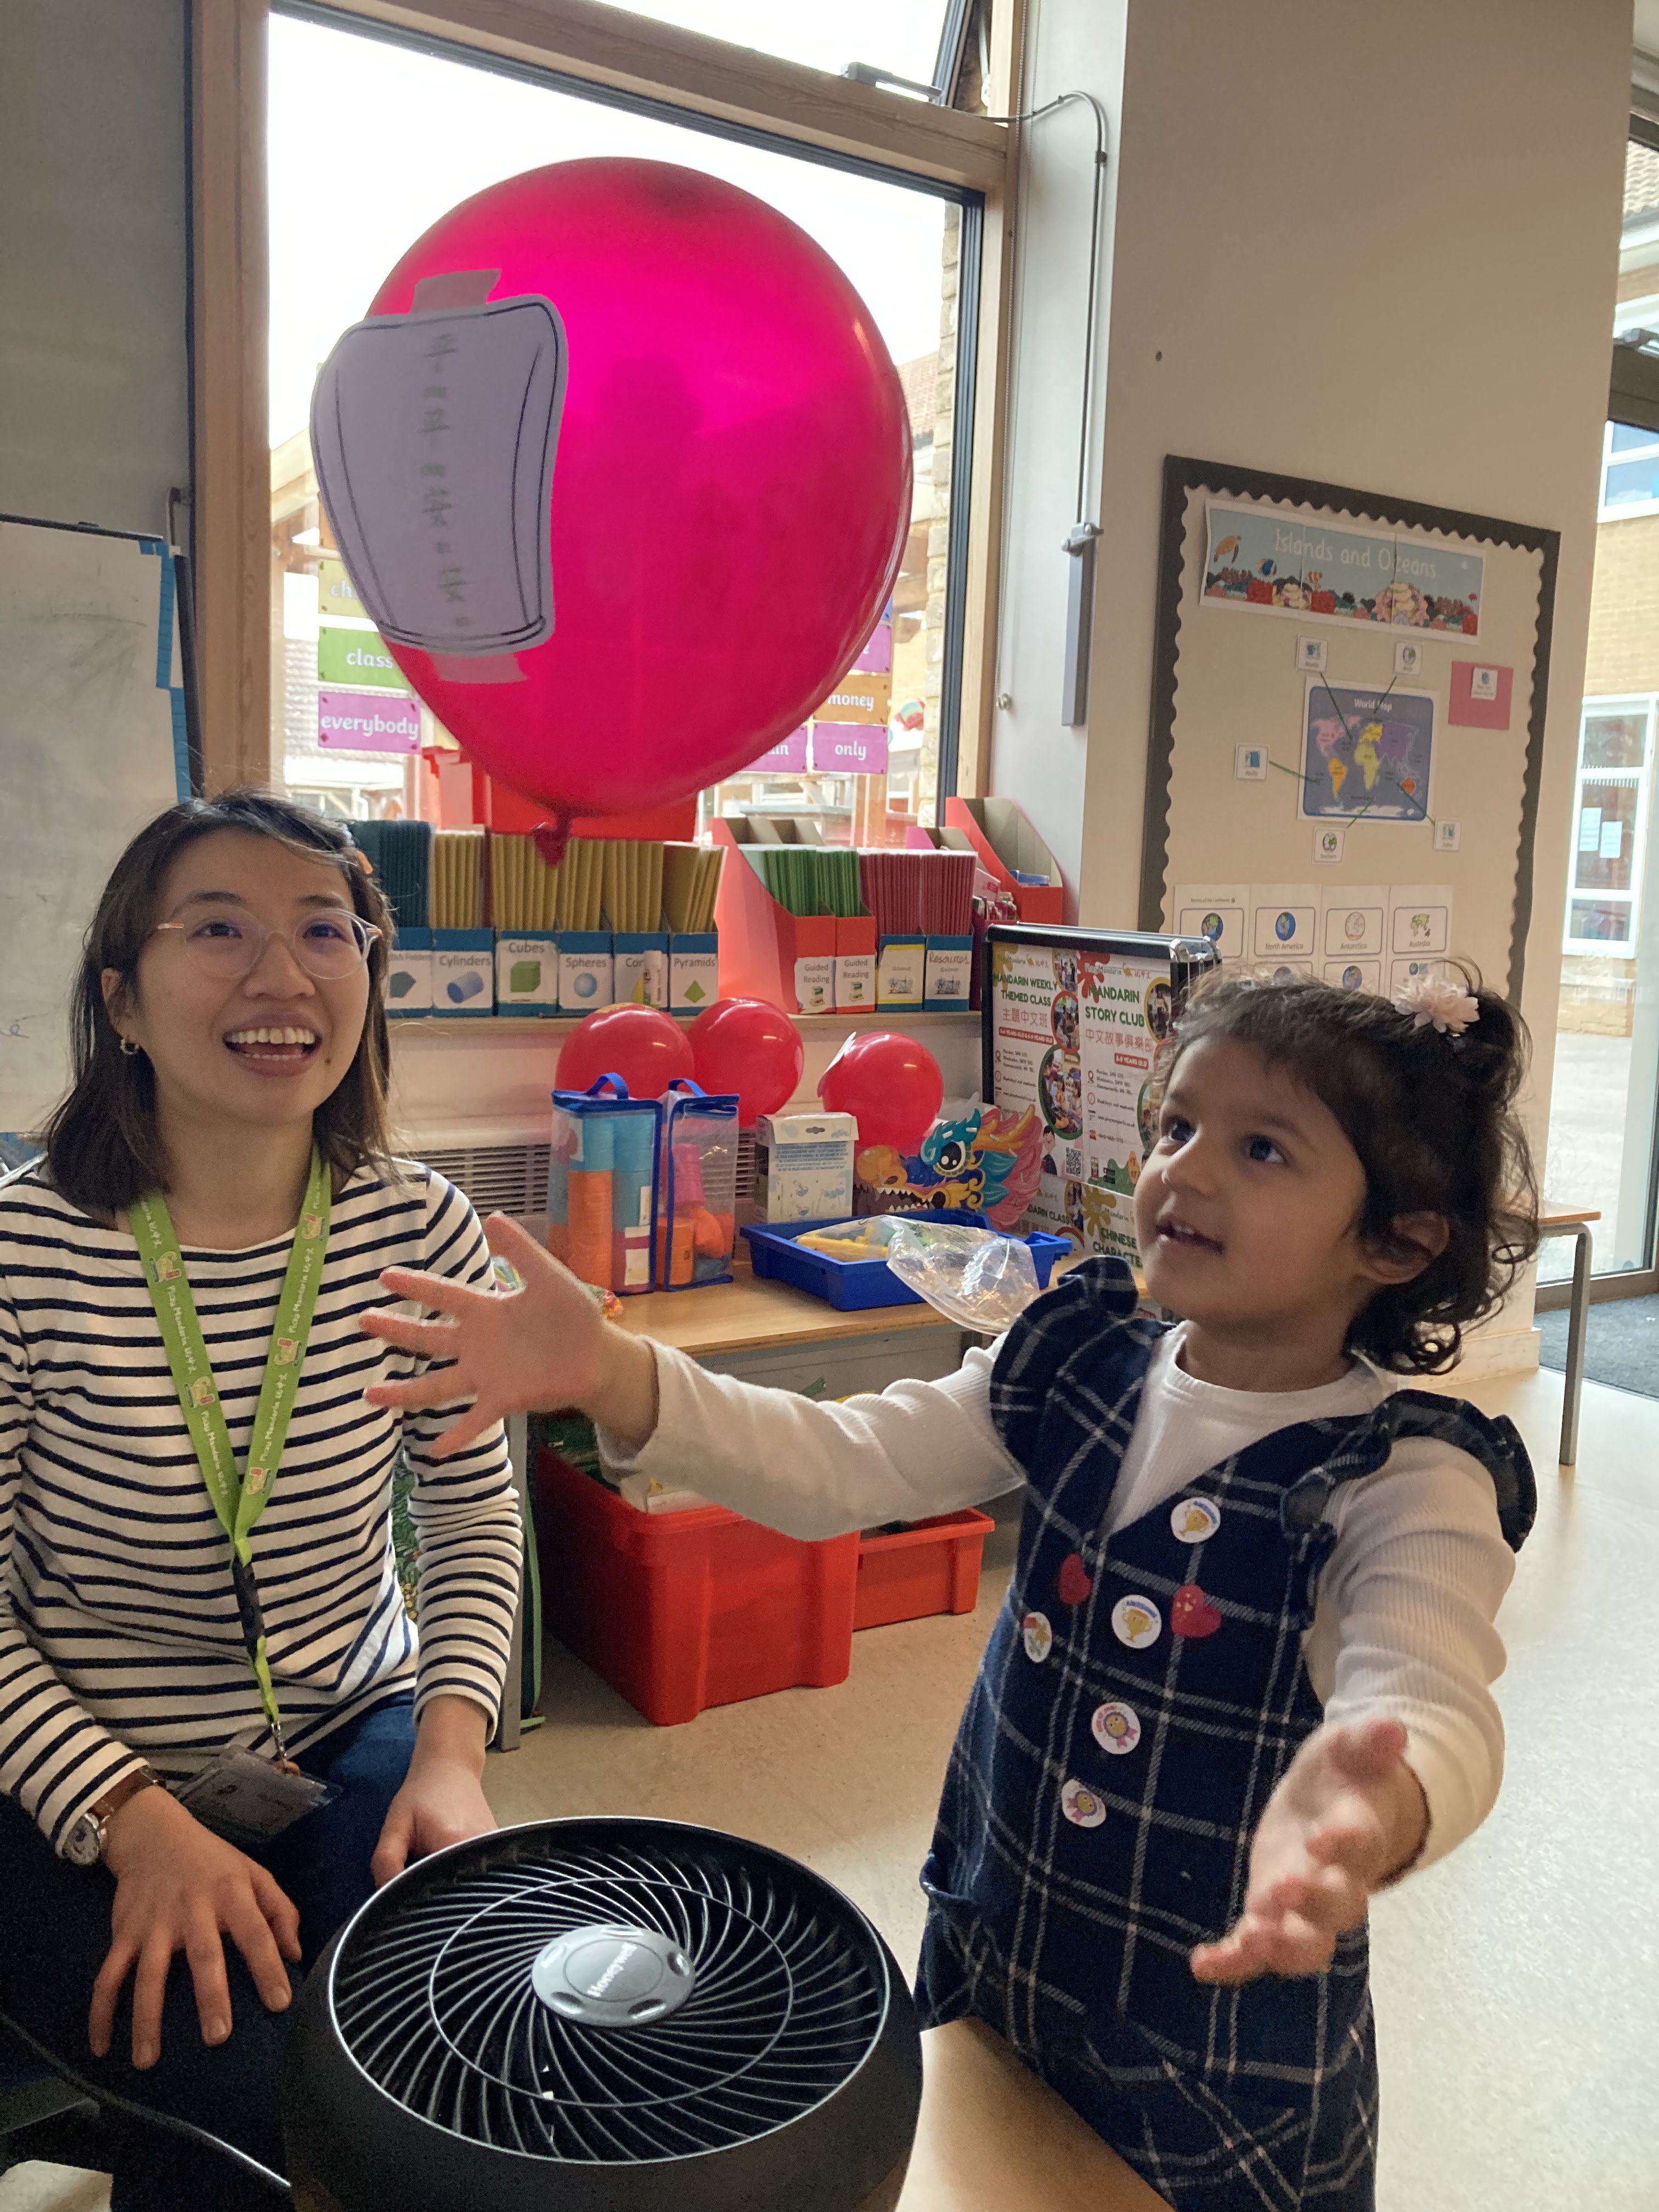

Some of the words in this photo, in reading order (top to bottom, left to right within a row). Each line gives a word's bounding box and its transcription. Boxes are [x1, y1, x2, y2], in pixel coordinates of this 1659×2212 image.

[1275, 527, 1333, 562] Islands
[1341, 546, 1370, 567] and
[346, 648, 394, 669] class
[827, 693, 874, 712] money
[1355, 698, 1374, 709] World
[320, 713, 419, 741] everybody
[835, 740, 867, 761] only
[509, 941, 545, 953] Cubes
[1266, 942, 1280, 950] North
[1281, 942, 1304, 950] America
[1340, 942, 1367, 950] Antarctica
[1409, 940, 1431, 948] Australia
[439, 955, 491, 968] Cylinders
[566, 957, 607, 970] Spheres
[674, 957, 715, 969] Pyramids
[929, 951, 970, 964] Resources
[1098, 964, 1122, 975] Mandarin
[804, 975, 830, 984] Reading
[994, 974, 1029, 986] MANDARIN
[1030, 977, 1058, 991] WEEKLY
[1001, 990, 1028, 1002] THEMED
[1030, 994, 1051, 1007] CLASS
[1089, 985, 1139, 1003] MANDARIN
[1003, 1008, 1047, 1028] 主題中文班
[1085, 1006, 1116, 1023] STORY
[1120, 1011, 1145, 1027] CLUB
[1124, 1056, 1138, 1066] YEARS
[1138, 1058, 1147, 1067] OLD
[1027, 1204, 1048, 1218] DARIN
[1049, 1211, 1069, 1225] CLASS
[1101, 1227, 1137, 1250] CHINESE
[1093, 1241, 1143, 1268] CHARACTE
[293, 1276, 308, 1312] Mandarin
[173, 1306, 189, 1346] Mandarin
[265, 1401, 280, 1440] Mandarin
[207, 1431, 220, 1470] Mandarin
